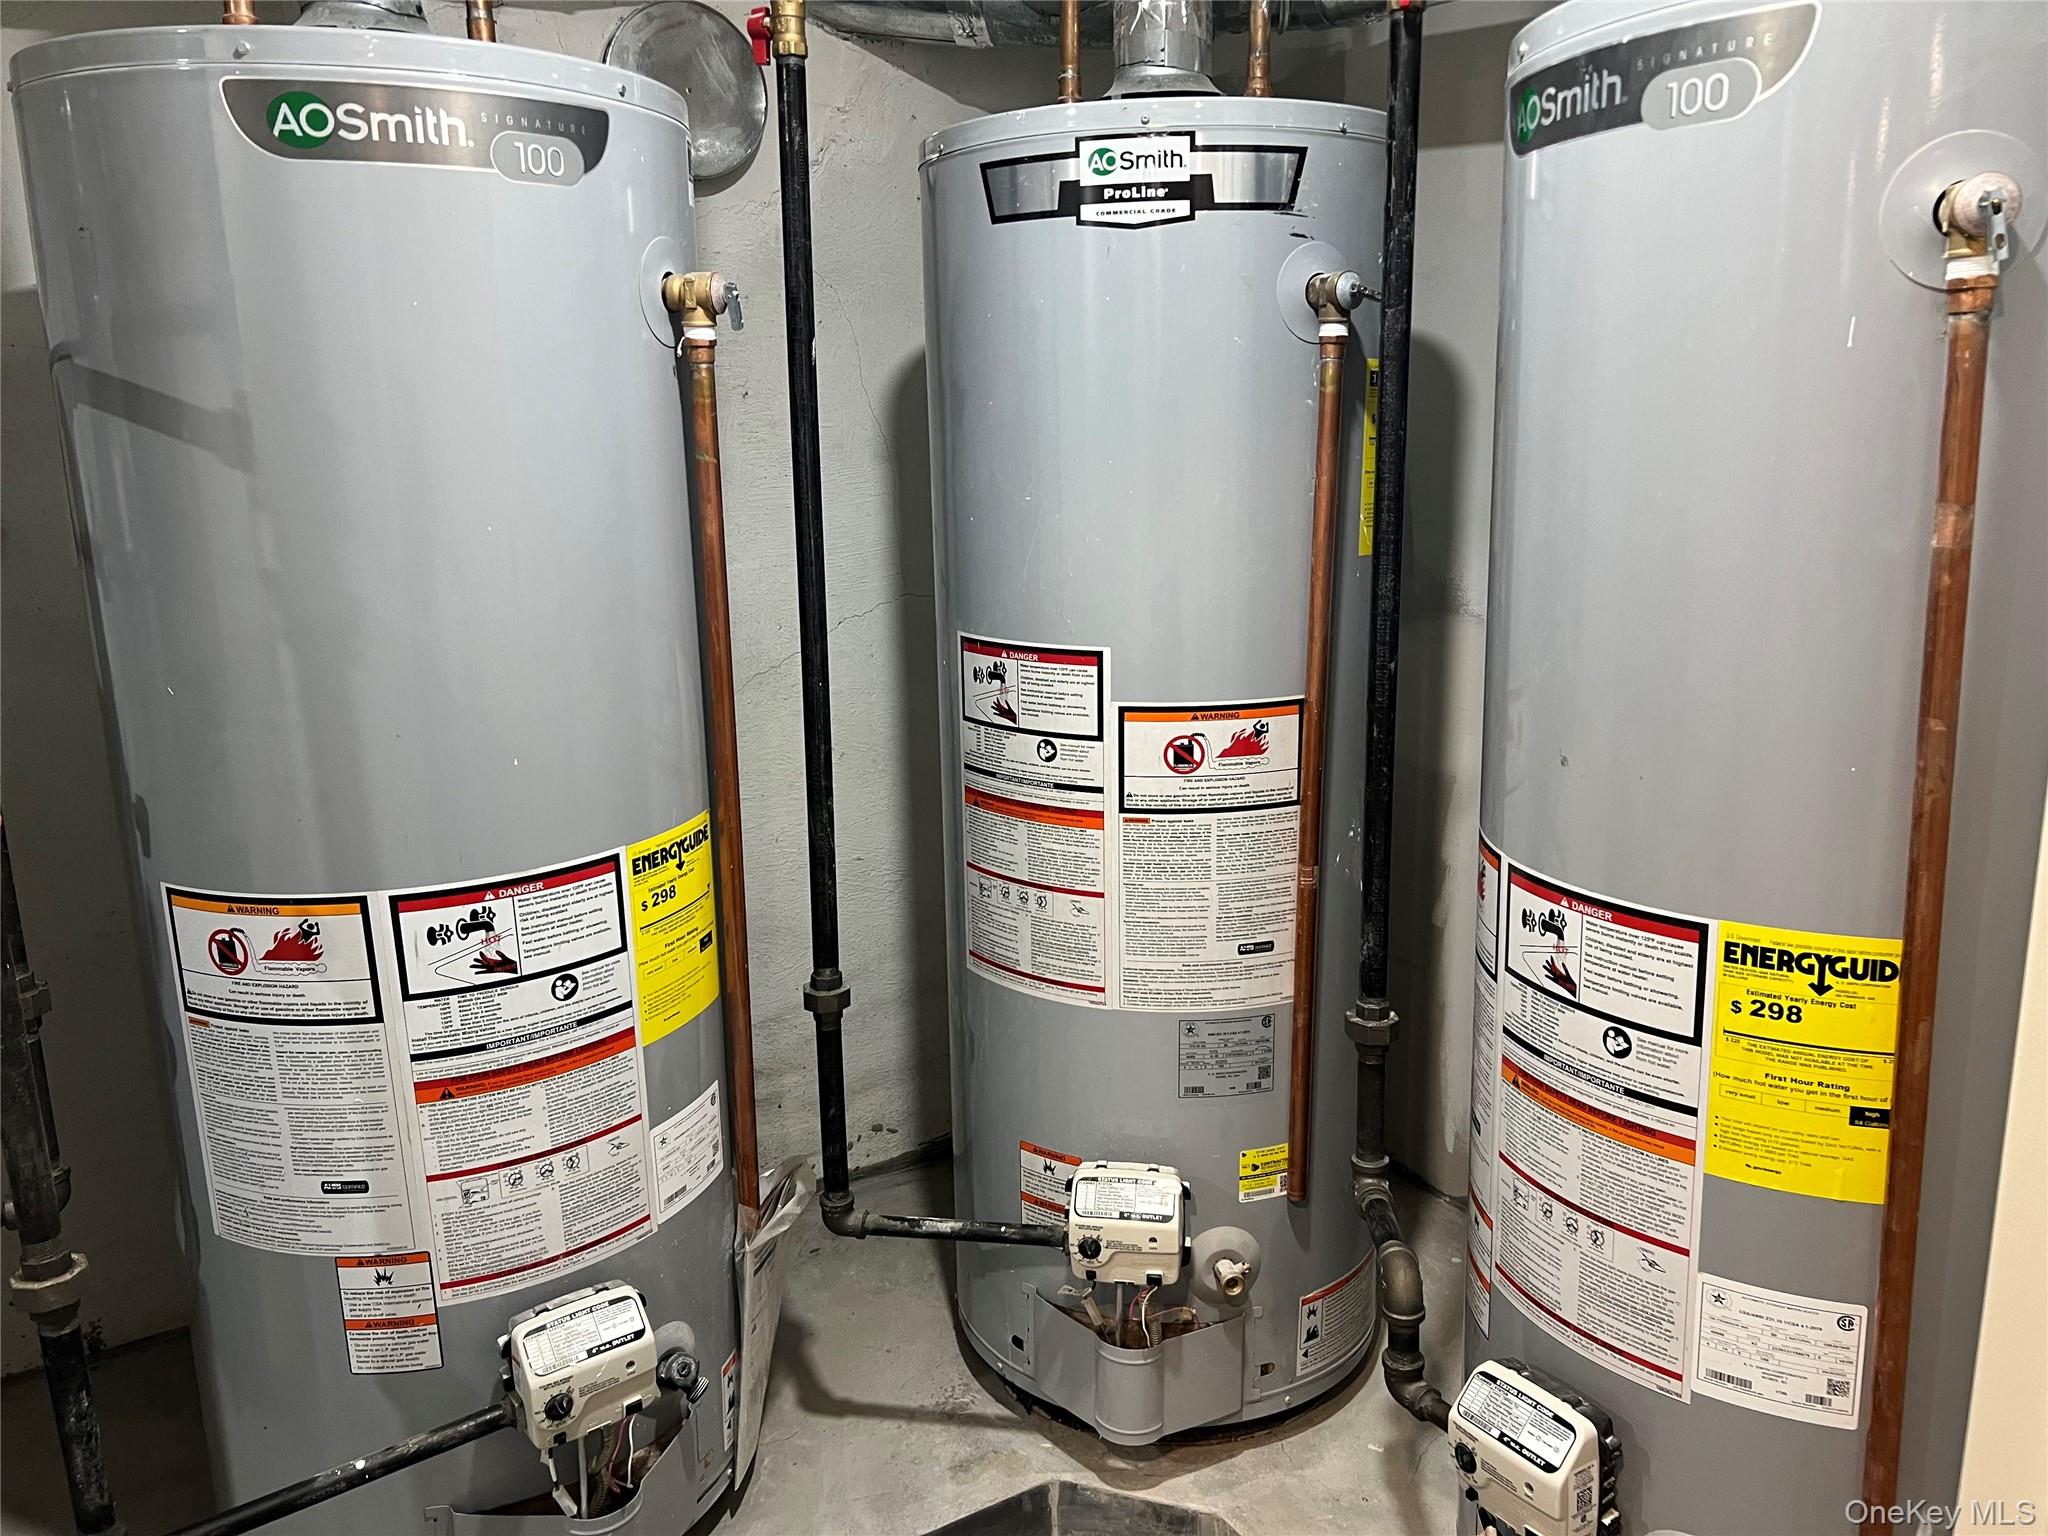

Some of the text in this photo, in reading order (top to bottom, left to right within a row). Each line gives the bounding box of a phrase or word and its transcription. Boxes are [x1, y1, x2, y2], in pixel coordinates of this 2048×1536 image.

[1636, 33, 1774, 71] SIGNATURE
[1667, 72, 1730, 118] 100
[480, 112, 588, 135] SIGNATURE
[513, 142, 565, 177] 100
[1104, 187, 1168, 200] ProLine
[1096, 207, 1177, 217] COMMERCIAL GRADE
[1009, 651, 1039, 662] DANGER
[1200, 711, 1240, 721] WARNING
[631, 823, 709, 877] ENERGYGUIDE
[498, 881, 544, 898] DANGER
[641, 884, 677, 912] $ 298
[235, 905, 280, 915] WARNING
[1572, 901, 1613, 922] DANGER
[295, 965, 315, 973] Vapors
[1637, 952, 1655, 960] elderly
[1672, 960, 1694, 969] highest
[1723, 940, 1900, 983] ENERGYGUID
[1638, 968, 1655, 977] before
[1656, 973, 1675, 982] setting
[1623, 980, 1642, 990] bathing
[1746, 988, 1857, 1010] Estimated Yearly Energy Cost
[1730, 999, 1804, 1024] $ 298
[486, 1021, 577, 1050] IMPORTANT/IMPORTANTE
[1754, 1049, 1774, 1057] MODEL
[1804, 1057, 1836, 1066] AVAILABLE
[1759, 1044, 1791, 1054] ESTIMATED
[1777, 1058, 1797, 1066] RANGE
[1543, 1054, 1625, 1095] IMPORTANT/IMPORTANTE
[1764, 1072, 1851, 1093] First Hour Rating
[1713, 1071, 1731, 1080] (How
[1732, 1075, 1753, 1085] much
[1753, 1079, 1767, 1088] hot
[1768, 1084, 1788, 1092] water
[1789, 1086, 1805, 1095] you
[1806, 1088, 1819, 1097] get
[1819, 1089, 1828, 1097] in
[1829, 1090, 1841, 1099] the
[1843, 1092, 1859, 1101] first
[1859, 1094, 1878, 1102] hour
[1740, 1091, 1756, 1099] small
[1776, 1099, 1790, 1107] low
[1260, 1158, 1288, 1167] CONTRACTO
[1119, 1177, 1137, 1185] LIGHT
[365, 1257, 407, 1266] WARNING
[546, 1301, 610, 1328] STATUS LIGHT CODE
[371, 1319, 415, 1328] WARNING
[612, 1334, 635, 1345] OUTLET
[1496, 1379, 1554, 1418] STATUS LIGHT CODE
[1521, 1448, 1546, 1466] OUTLET
